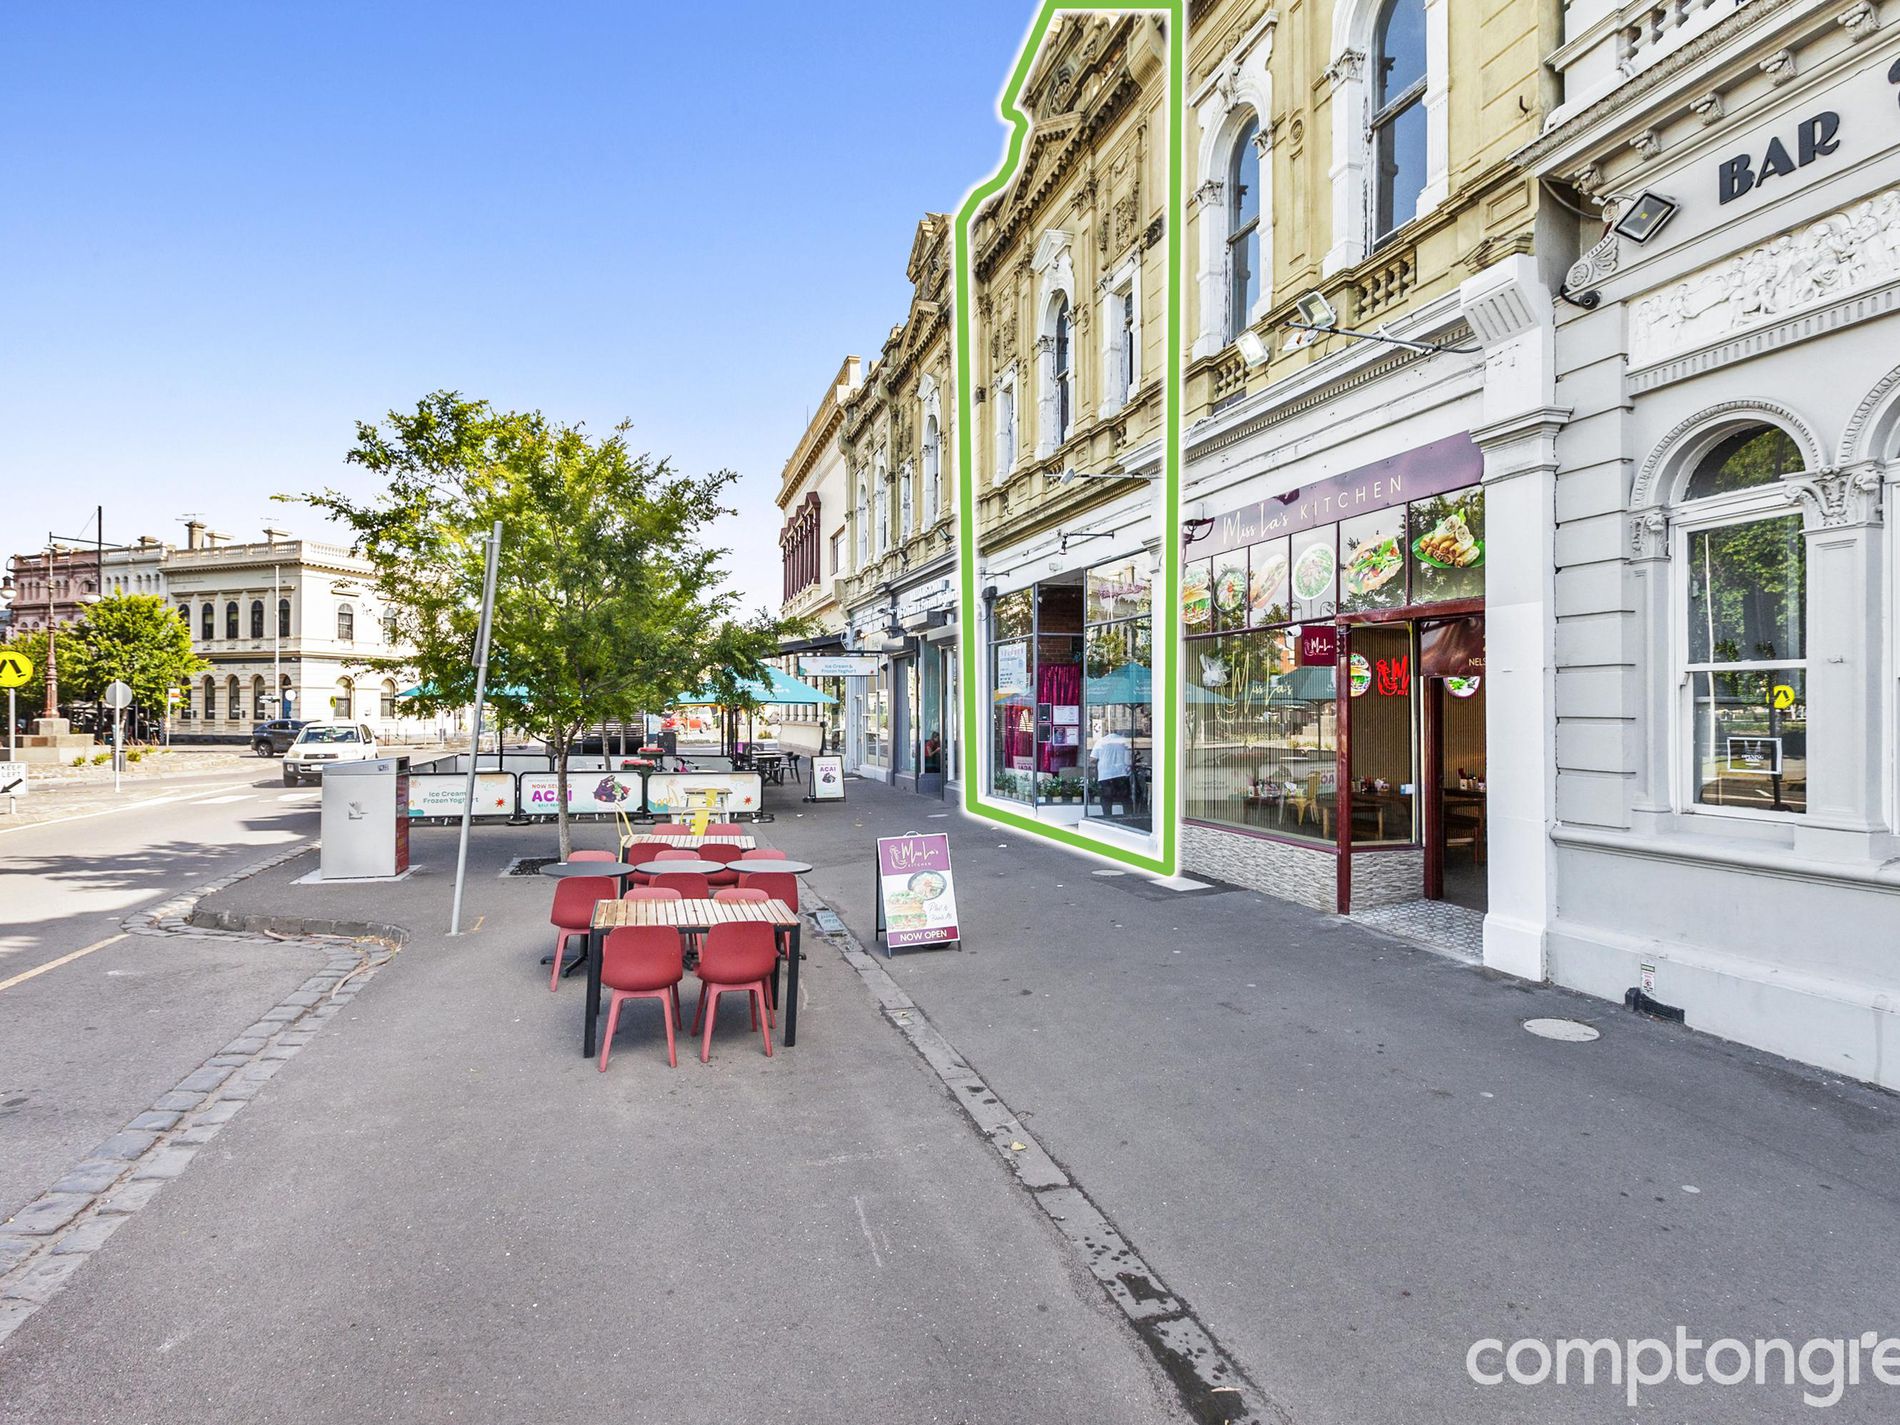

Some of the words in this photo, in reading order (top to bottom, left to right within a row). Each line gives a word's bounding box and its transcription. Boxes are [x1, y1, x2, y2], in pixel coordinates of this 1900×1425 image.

[1719, 111, 1841, 205] BAR
[1222, 511, 1255, 545] Miss
[1259, 503, 1288, 537] La's
[1300, 475, 1402, 520] KITCHEN
[531, 789, 573, 802] ACI
[900, 932, 922, 942] NOW
[924, 930, 948, 940] OPEN
